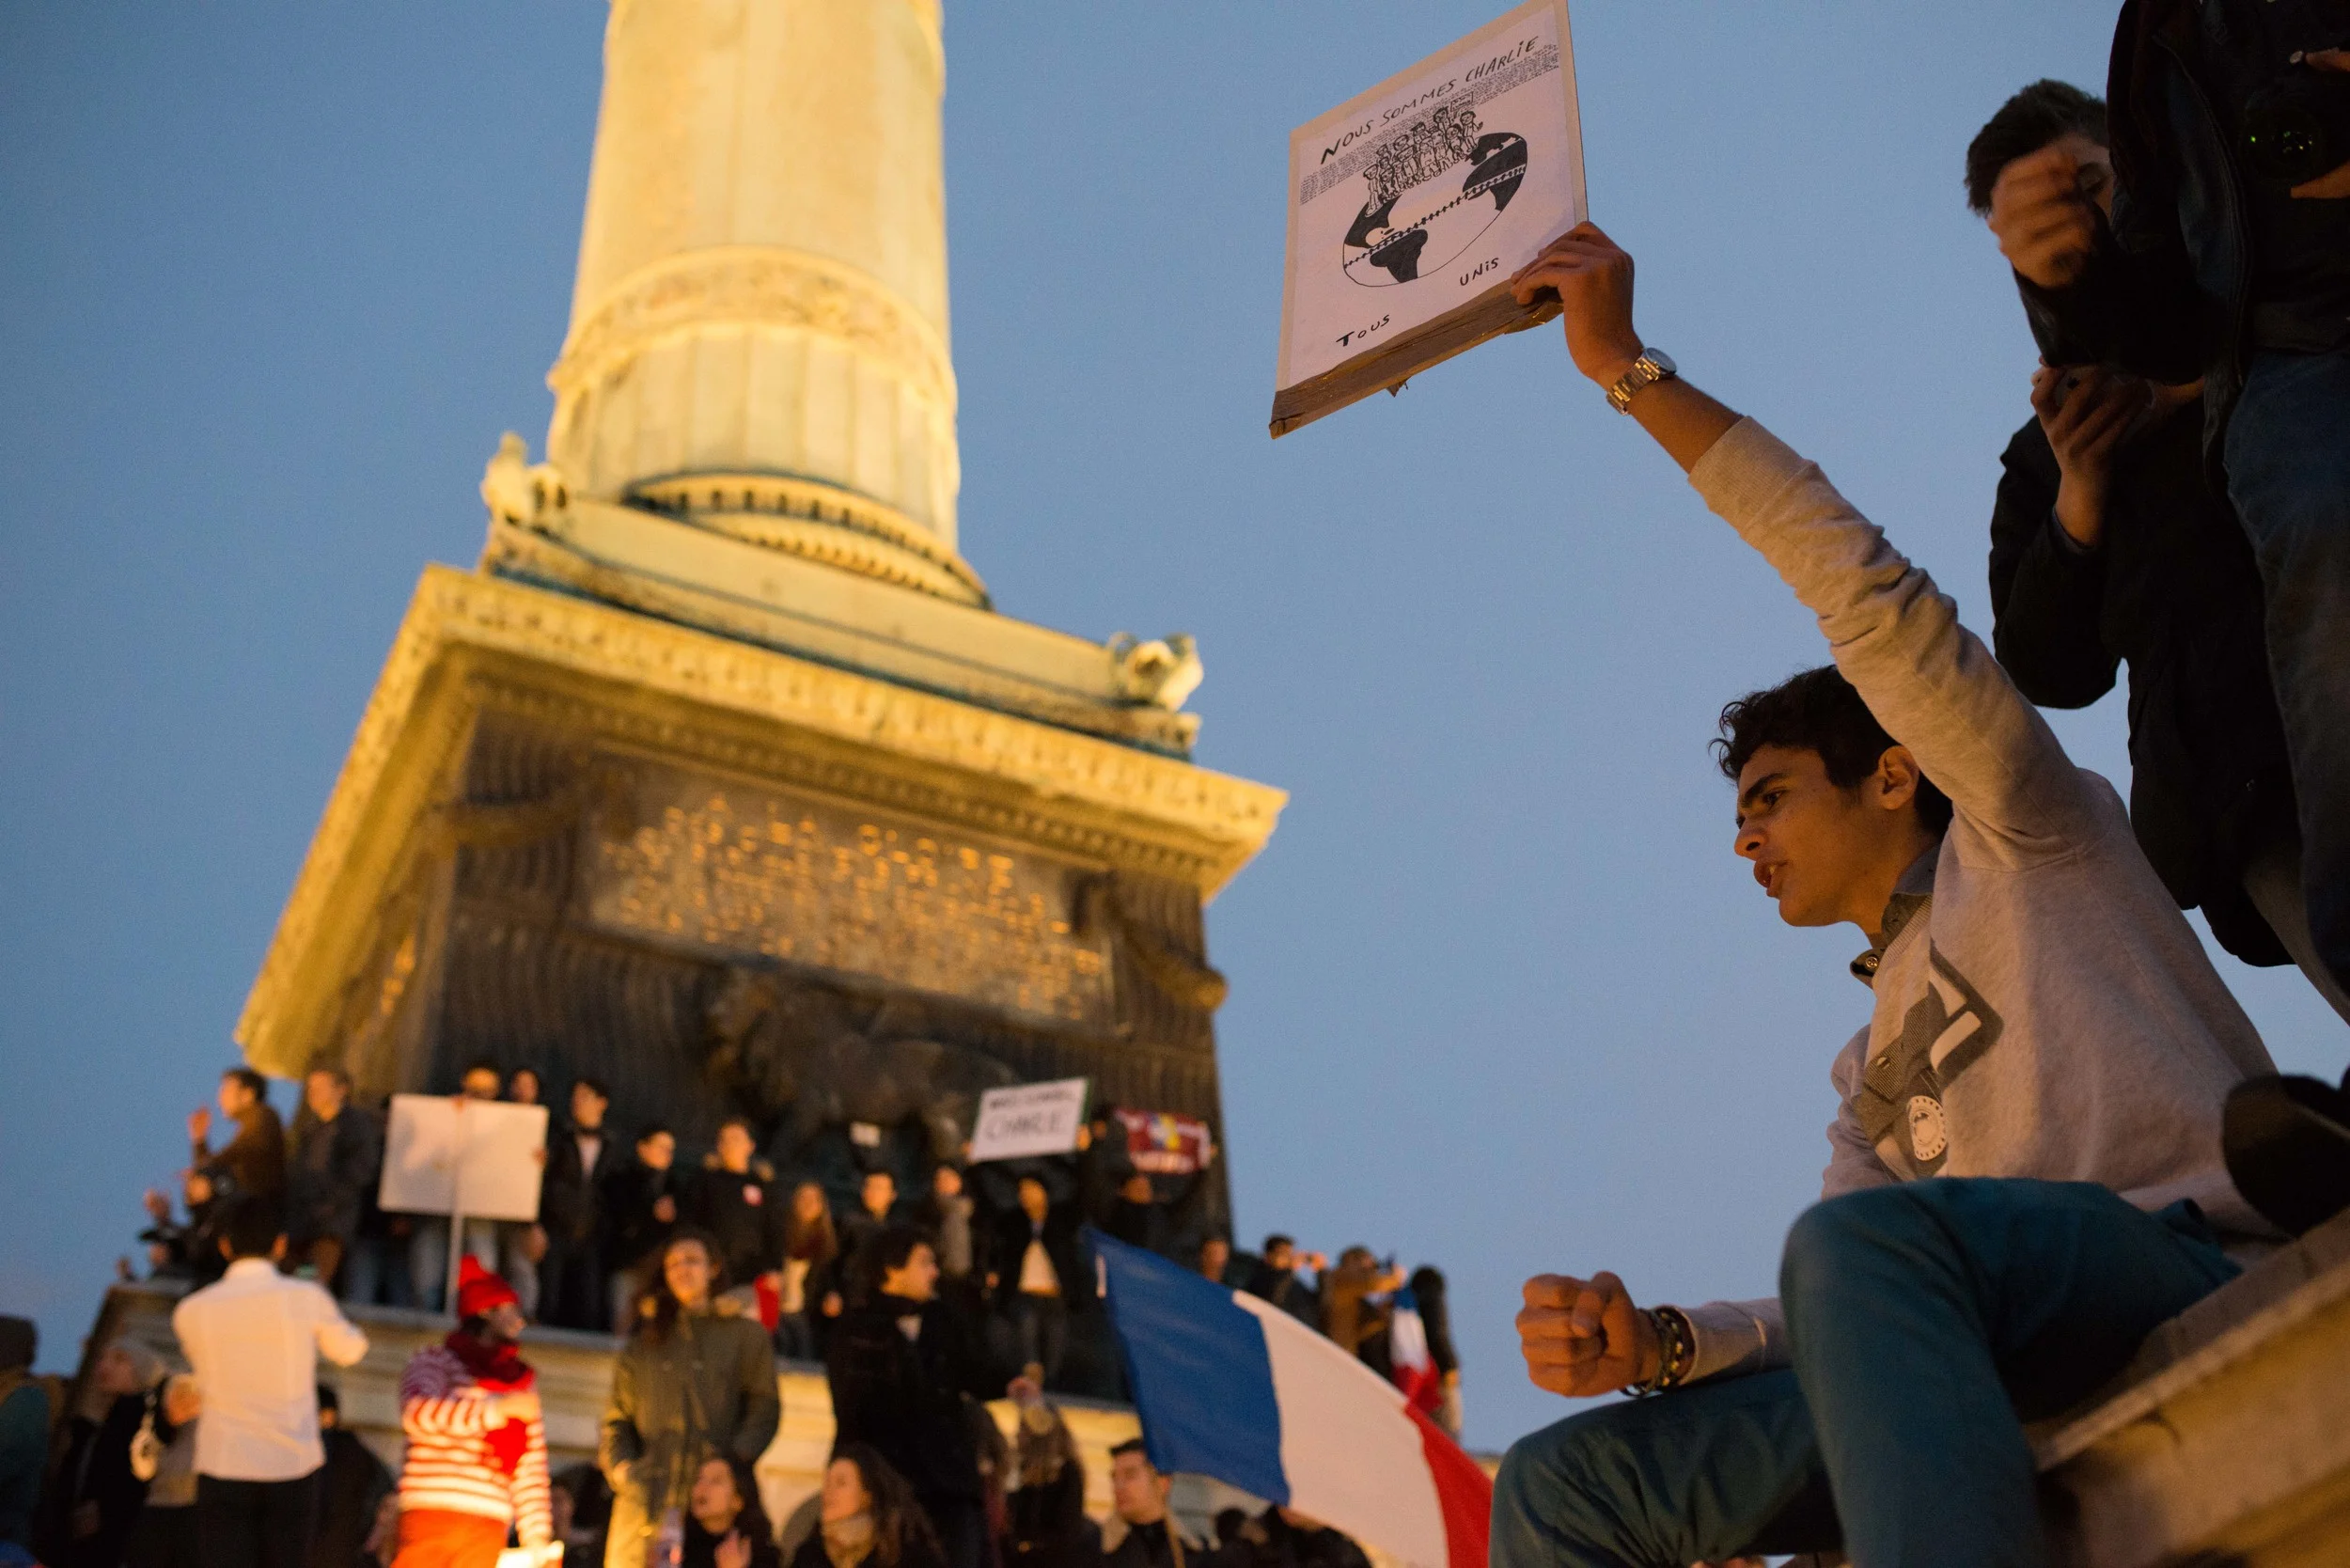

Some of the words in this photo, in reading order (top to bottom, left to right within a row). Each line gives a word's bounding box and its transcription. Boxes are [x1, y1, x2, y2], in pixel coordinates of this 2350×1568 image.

[1320, 119, 1374, 165] NOUS
[1379, 79, 1457, 128] SOMMES
[1336, 314, 1390, 347] TOUS
